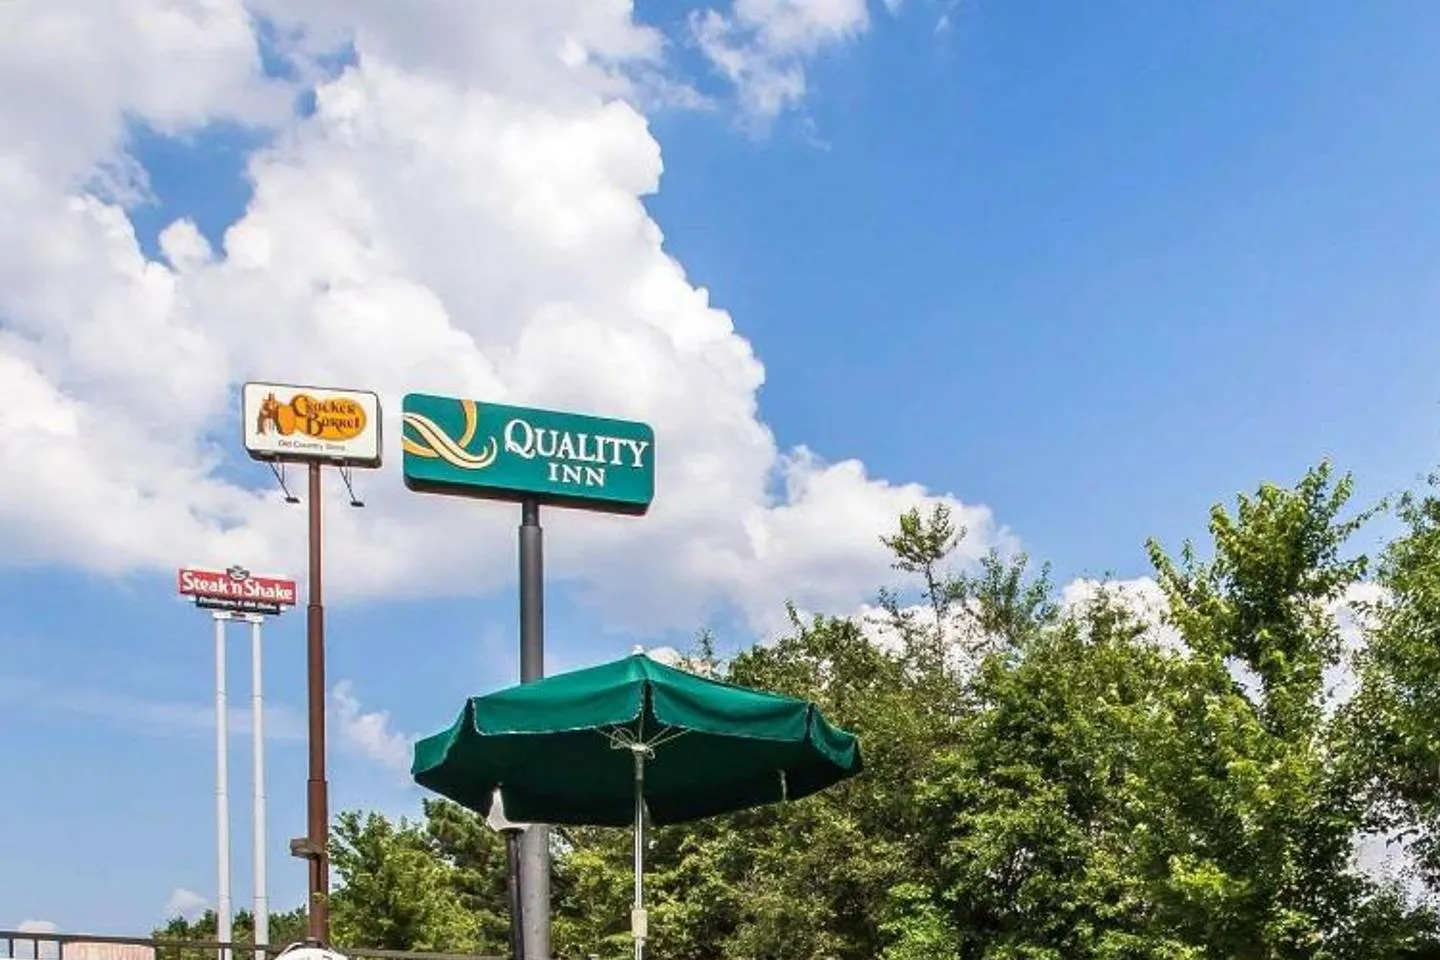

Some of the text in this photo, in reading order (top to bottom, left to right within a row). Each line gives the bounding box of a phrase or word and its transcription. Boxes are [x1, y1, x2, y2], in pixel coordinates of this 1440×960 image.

[291, 394, 356, 417] Cracker
[307, 412, 360, 436] Barrel
[504, 419, 649, 468] QUALITY
[548, 462, 606, 487] INN
[243, 579, 293, 600] Shake
